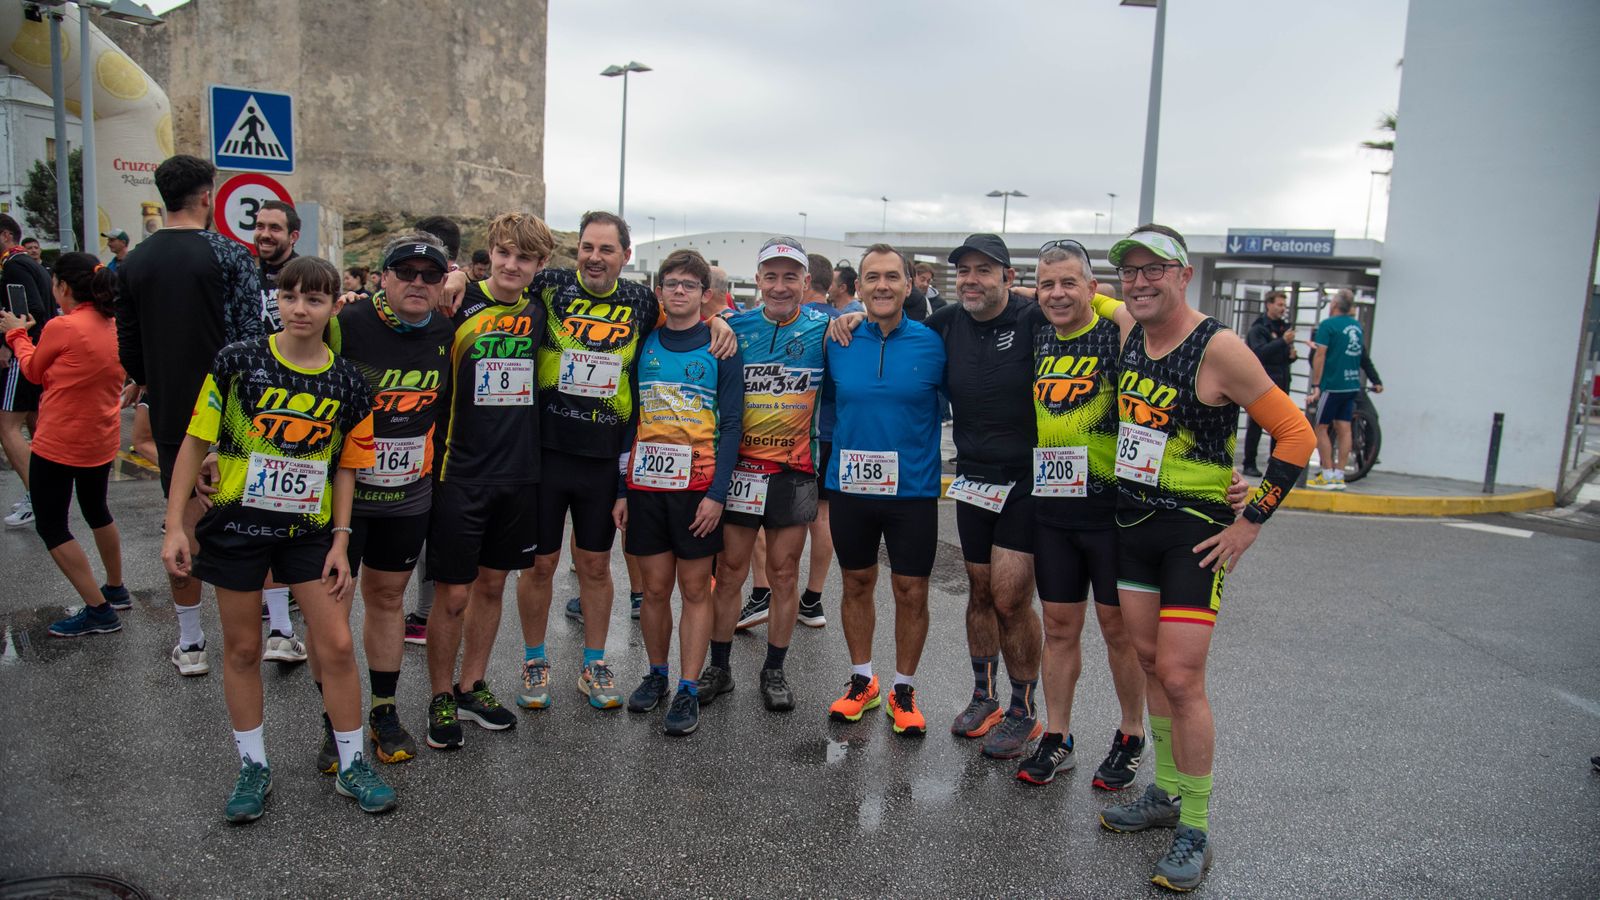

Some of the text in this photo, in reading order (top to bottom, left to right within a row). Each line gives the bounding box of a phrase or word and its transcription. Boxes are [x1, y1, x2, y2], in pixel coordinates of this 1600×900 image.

[113, 158, 160, 172] Cruzca
[121, 174, 154, 187] Radle
[239, 197, 264, 231] 3
[1262, 238, 1331, 253] Peatones
[566, 298, 632, 322] non
[474, 315, 532, 335] non
[558, 317, 631, 343] STOP
[470, 337, 533, 359] STOP
[486, 361, 504, 371] XIV
[571, 353, 592, 363] XIV
[1037, 355, 1099, 376] non
[378, 368, 439, 388] non
[500, 371, 509, 390] 8
[586, 363, 596, 381] 7
[745, 365, 782, 379] TRAIL
[744, 380, 772, 392] EAM
[1033, 379, 1094, 403] STOP
[1120, 370, 1177, 408] non
[256, 386, 340, 420] non
[372, 391, 438, 412] STOP
[246, 413, 332, 445] STOP
[374, 441, 395, 451] XIV
[645, 445, 660, 455] XIV
[741, 435, 796, 447] lgeciras
[1119, 438, 1140, 460] 85
[263, 458, 289, 471] XIV
[376, 451, 410, 471] 164
[646, 455, 675, 473] 202
[849, 454, 866, 462] XIV
[1042, 451, 1057, 460] XIV
[853, 462, 882, 480] 158
[1046, 460, 1074, 480] 208
[269, 470, 307, 495] 165
[727, 480, 751, 498] 201
